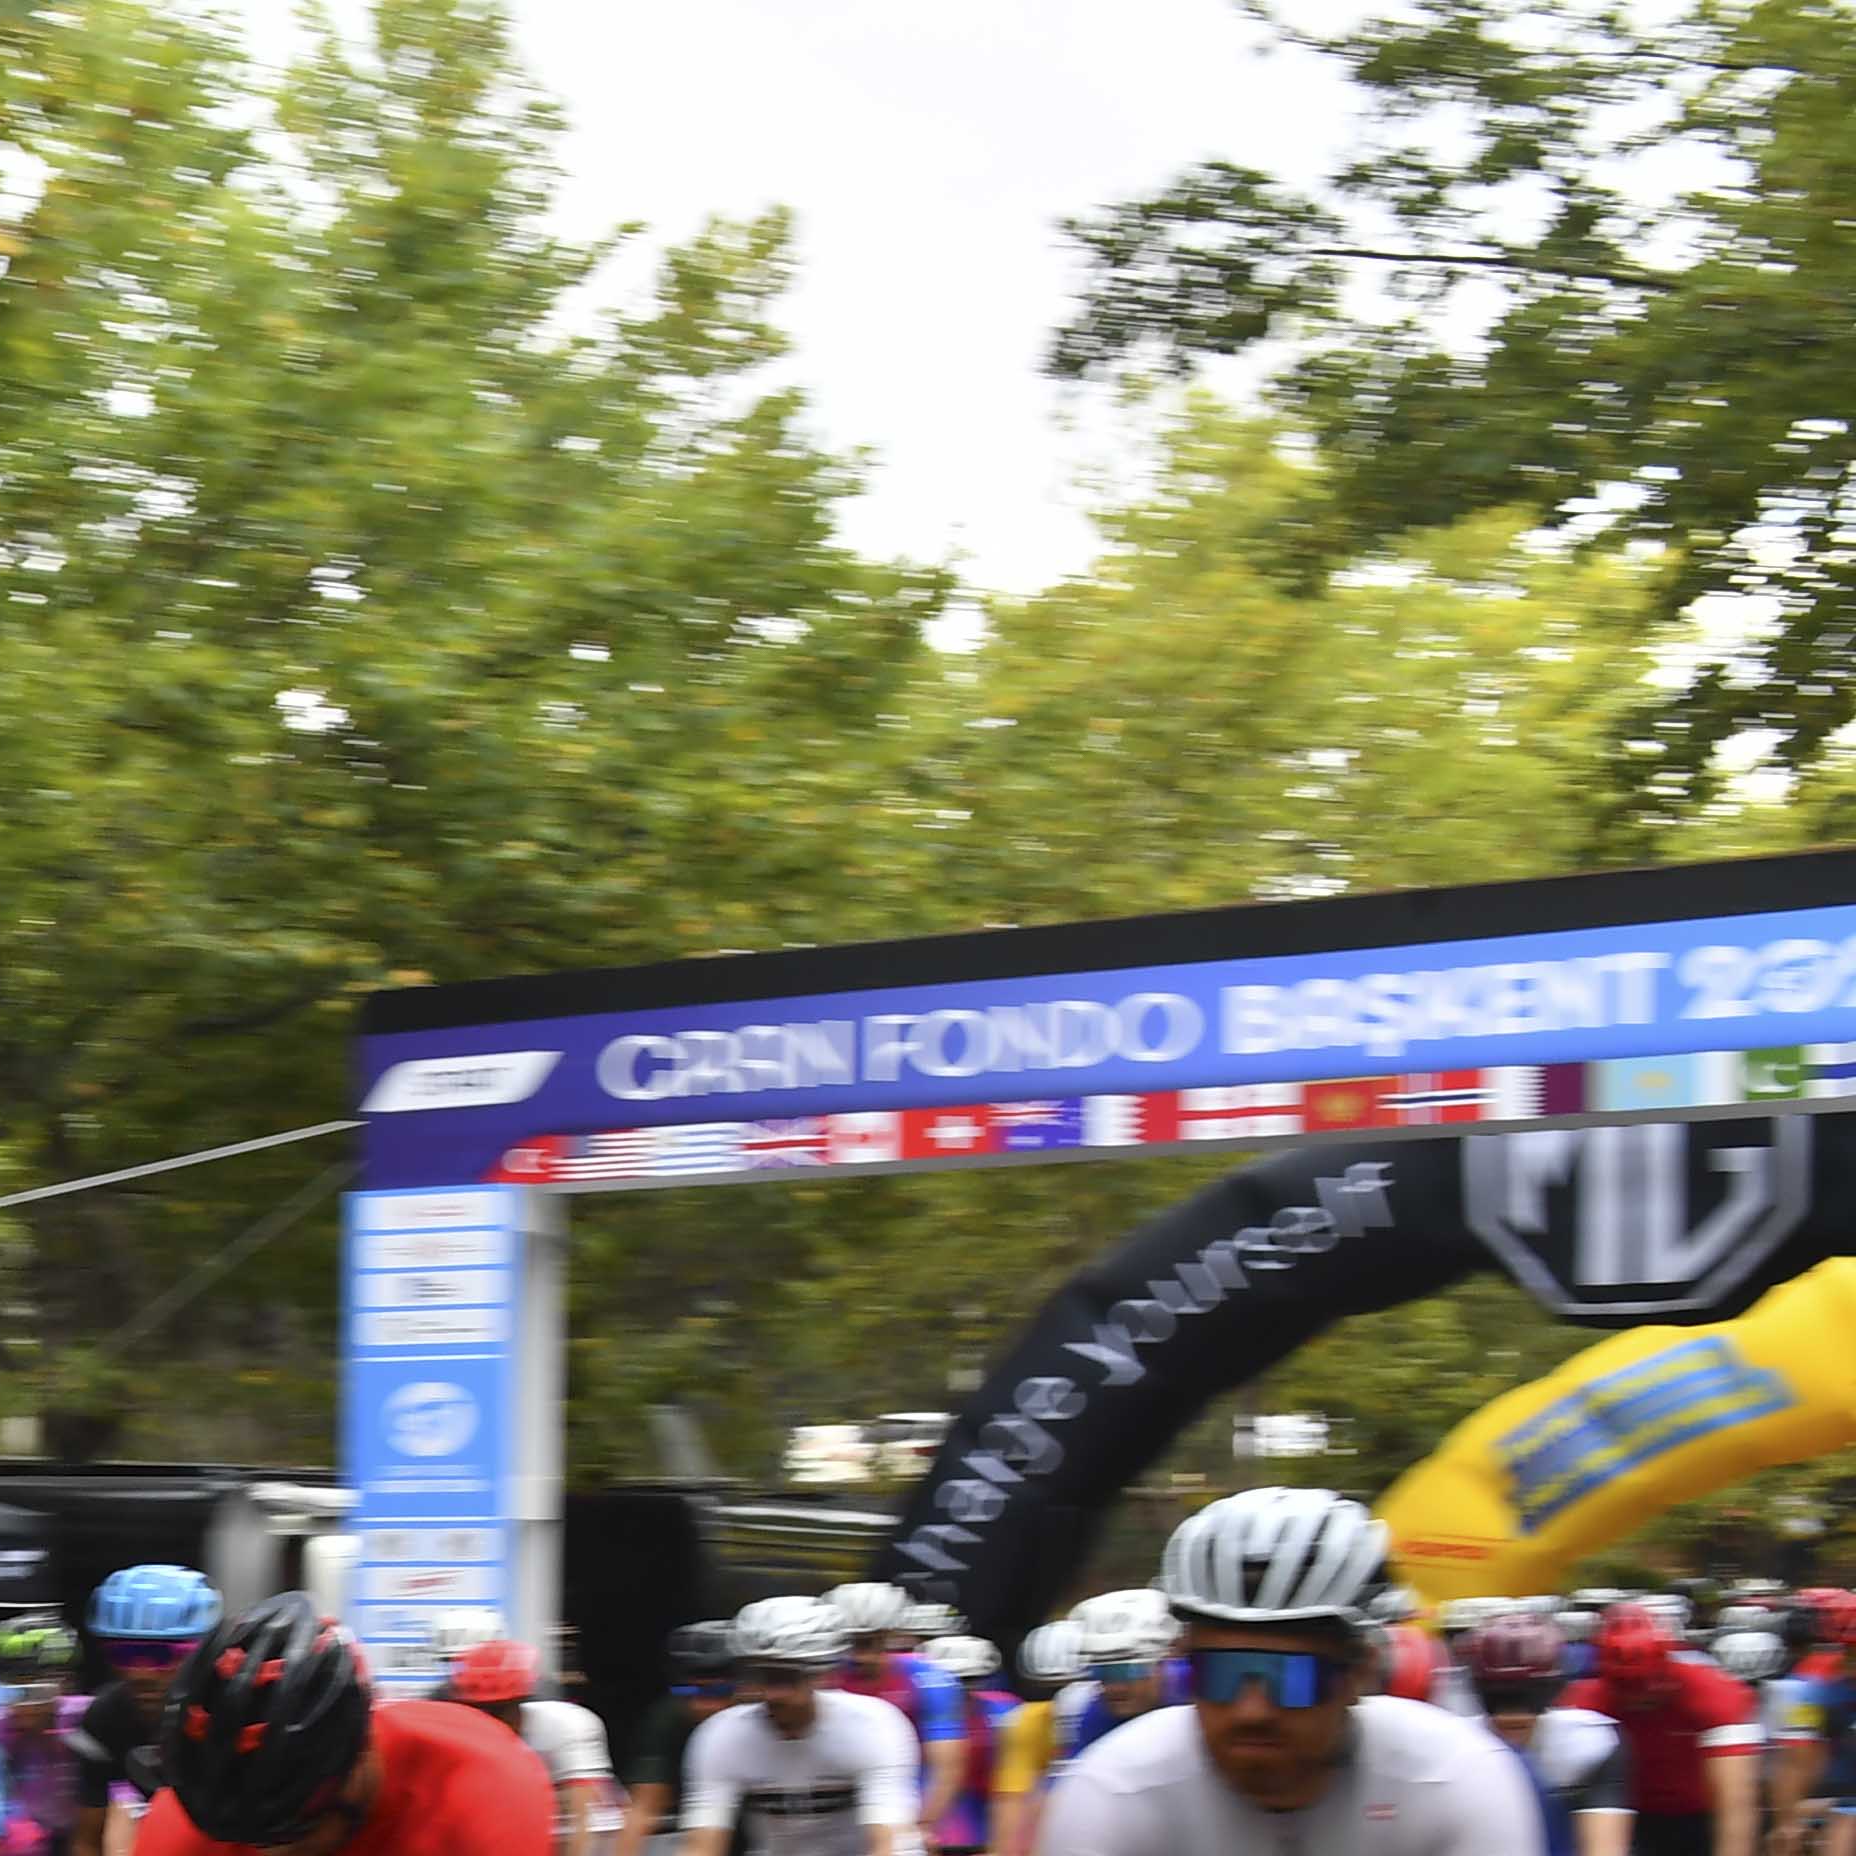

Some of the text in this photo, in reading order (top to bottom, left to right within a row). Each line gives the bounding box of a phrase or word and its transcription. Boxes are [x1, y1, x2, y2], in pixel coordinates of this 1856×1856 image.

[595, 1019, 856, 1100] GRAN
[862, 992, 1204, 1082] FONDO
[1061, 1161, 1395, 1387] yourself
